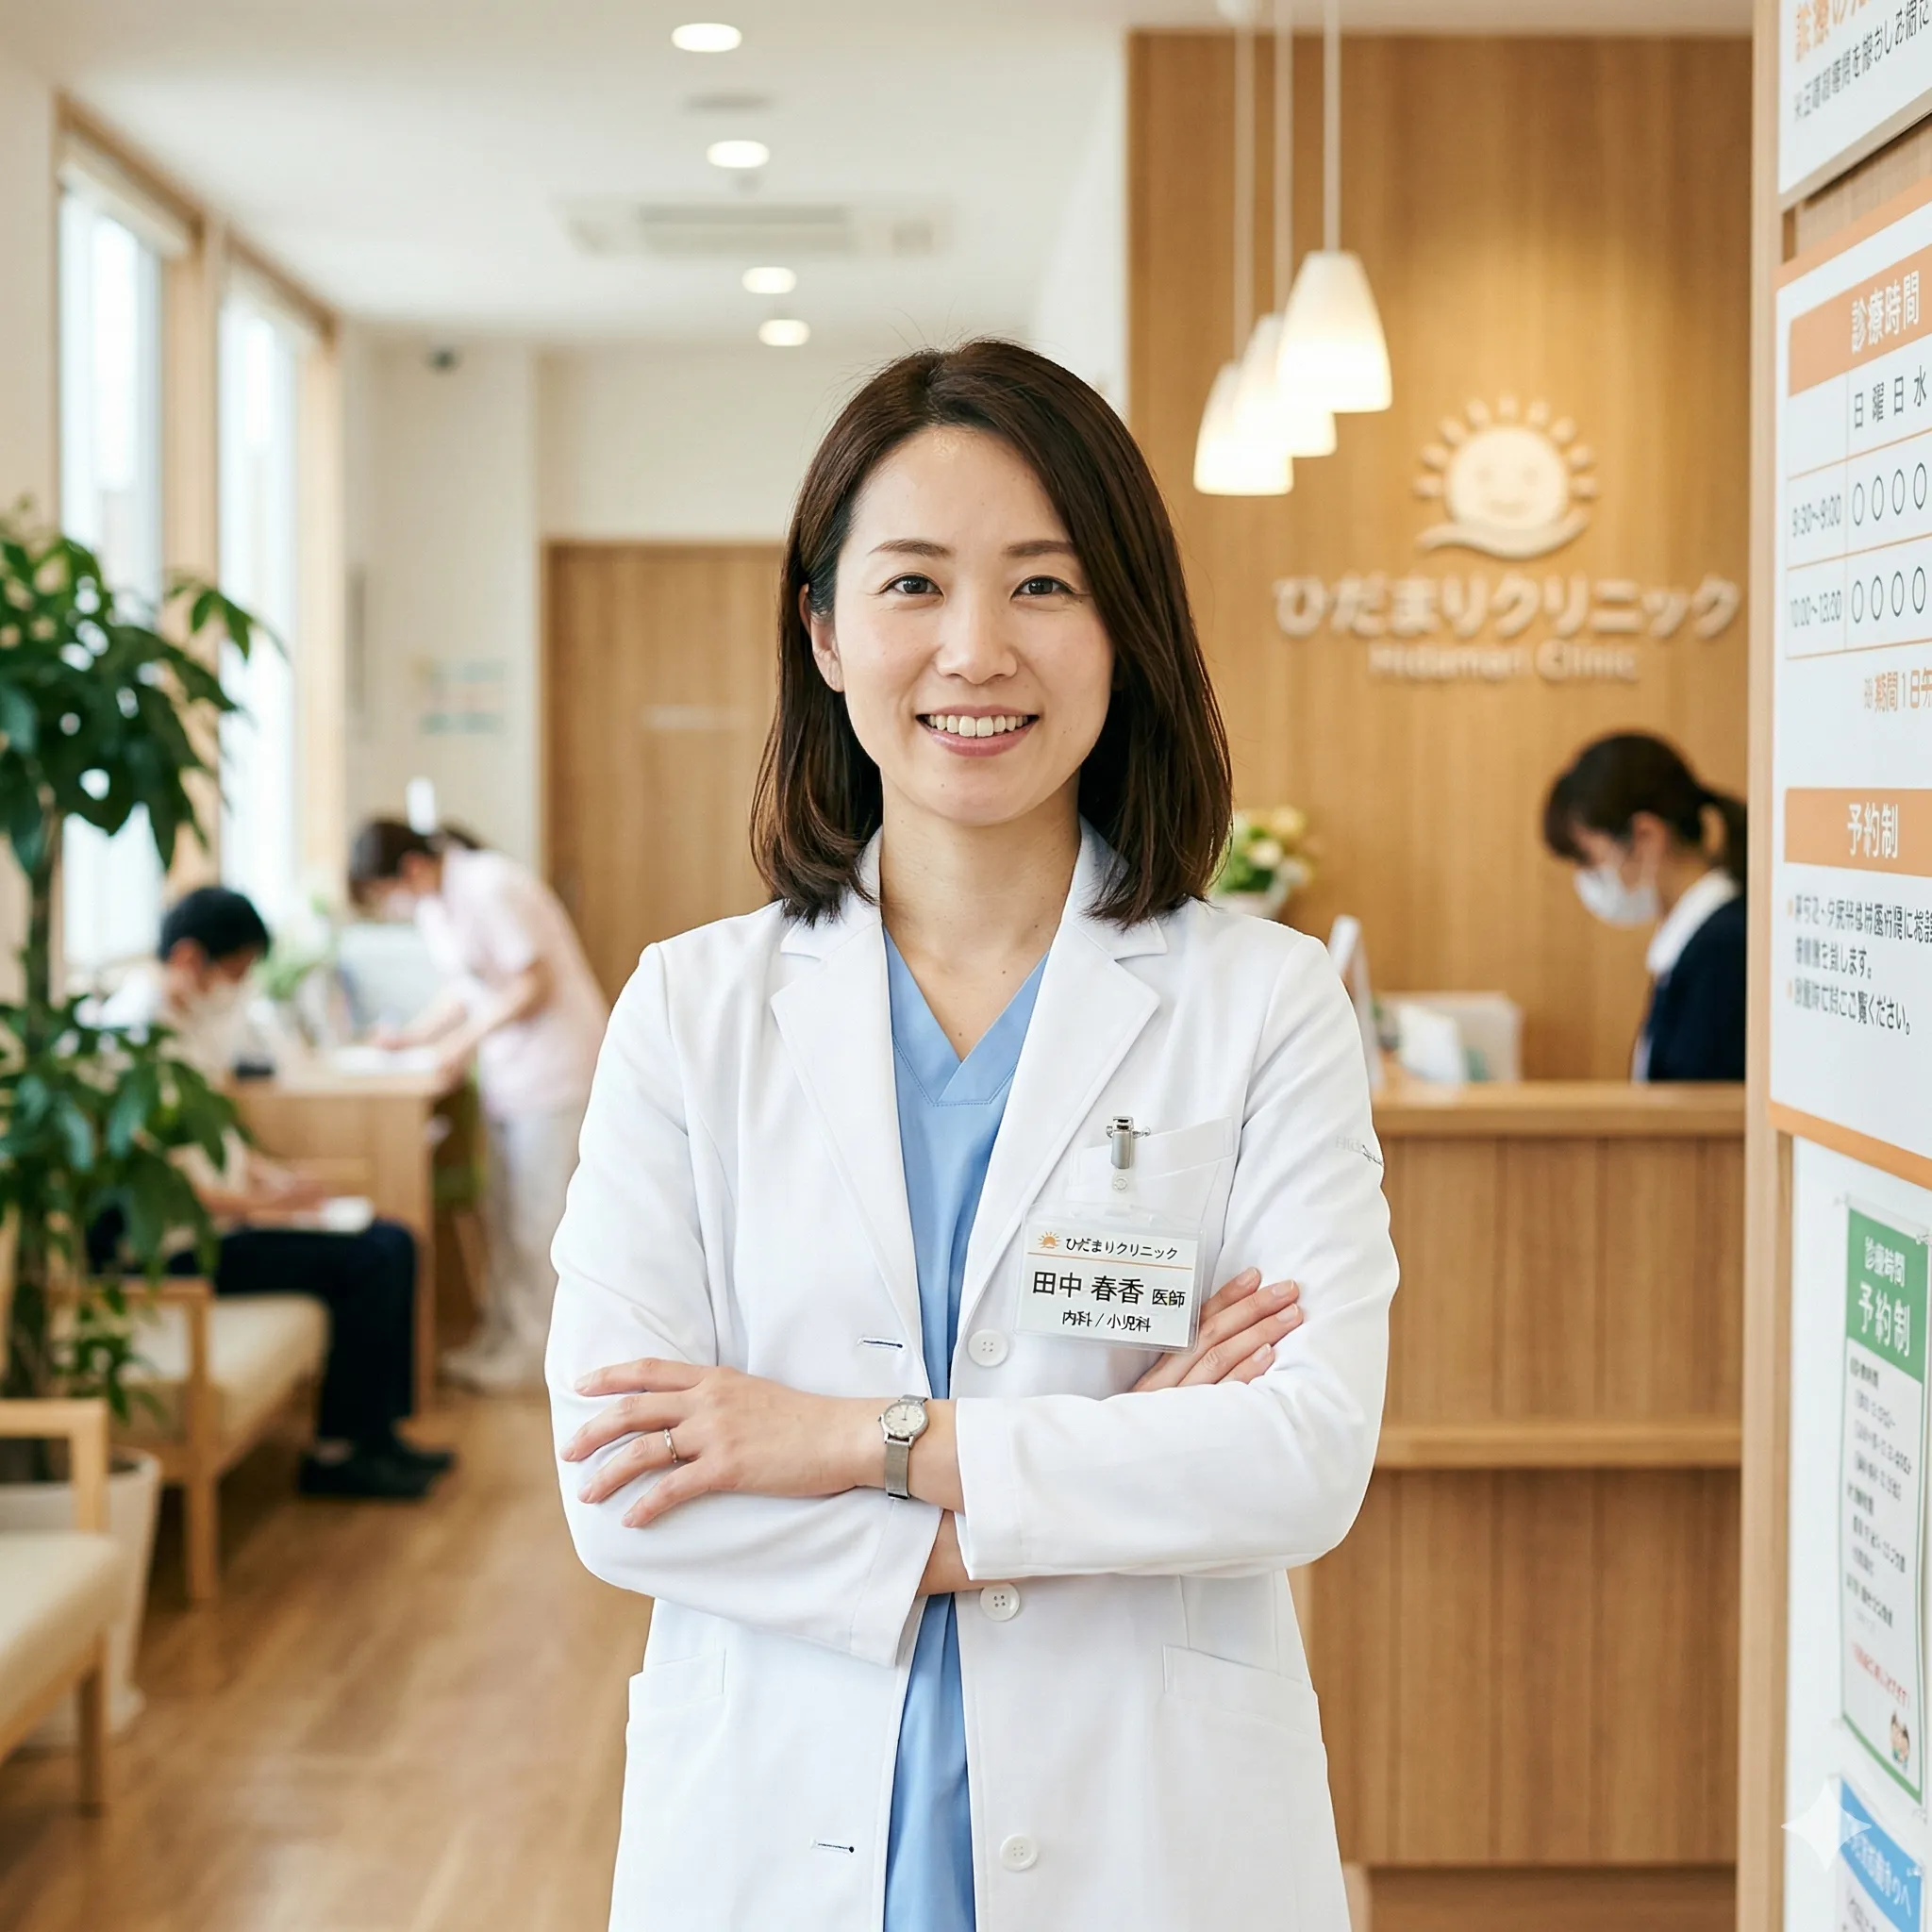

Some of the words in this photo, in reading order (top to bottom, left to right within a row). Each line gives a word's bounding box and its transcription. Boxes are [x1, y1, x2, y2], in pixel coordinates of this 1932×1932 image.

[1851, 270, 1920, 355] 診療時間
[1273, 571, 1741, 640] ひだまりクリニック
[1847, 802, 1899, 858] 予約制
[1065, 1238, 1178, 1259] ひだまりクリニック
[1033, 1271, 1082, 1298] 田中
[1091, 1275, 1144, 1305] 春香
[1151, 1289, 1187, 1308] 医師
